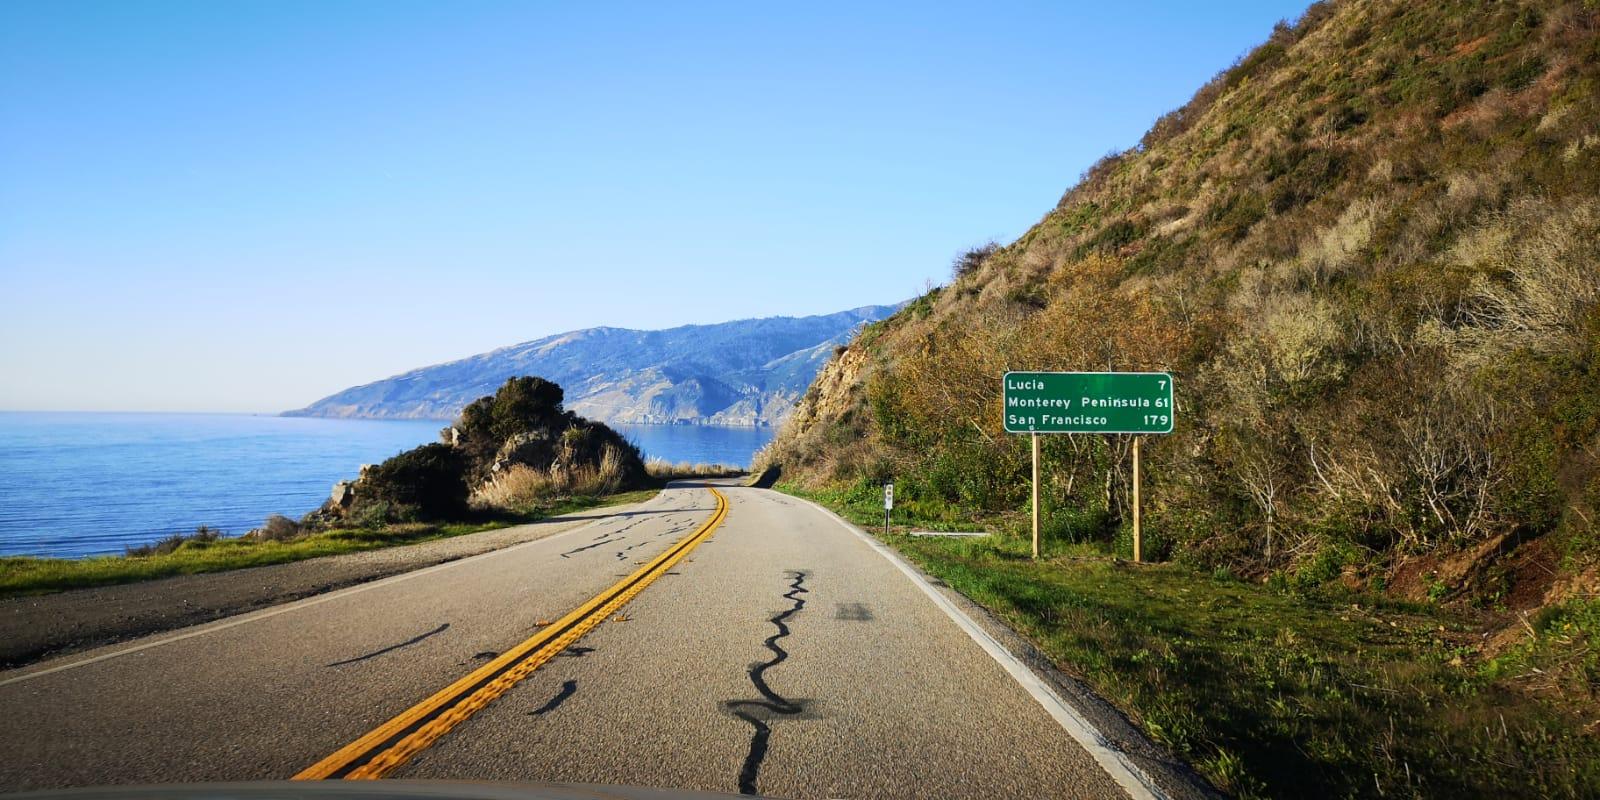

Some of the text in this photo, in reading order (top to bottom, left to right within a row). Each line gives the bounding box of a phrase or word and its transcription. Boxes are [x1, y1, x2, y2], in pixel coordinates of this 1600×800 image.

[1008, 379, 1167, 390] Lucia 7
[1008, 397, 1169, 410] Monterey Peninsula 61
[1009, 414, 1169, 425] San Francisco 179
